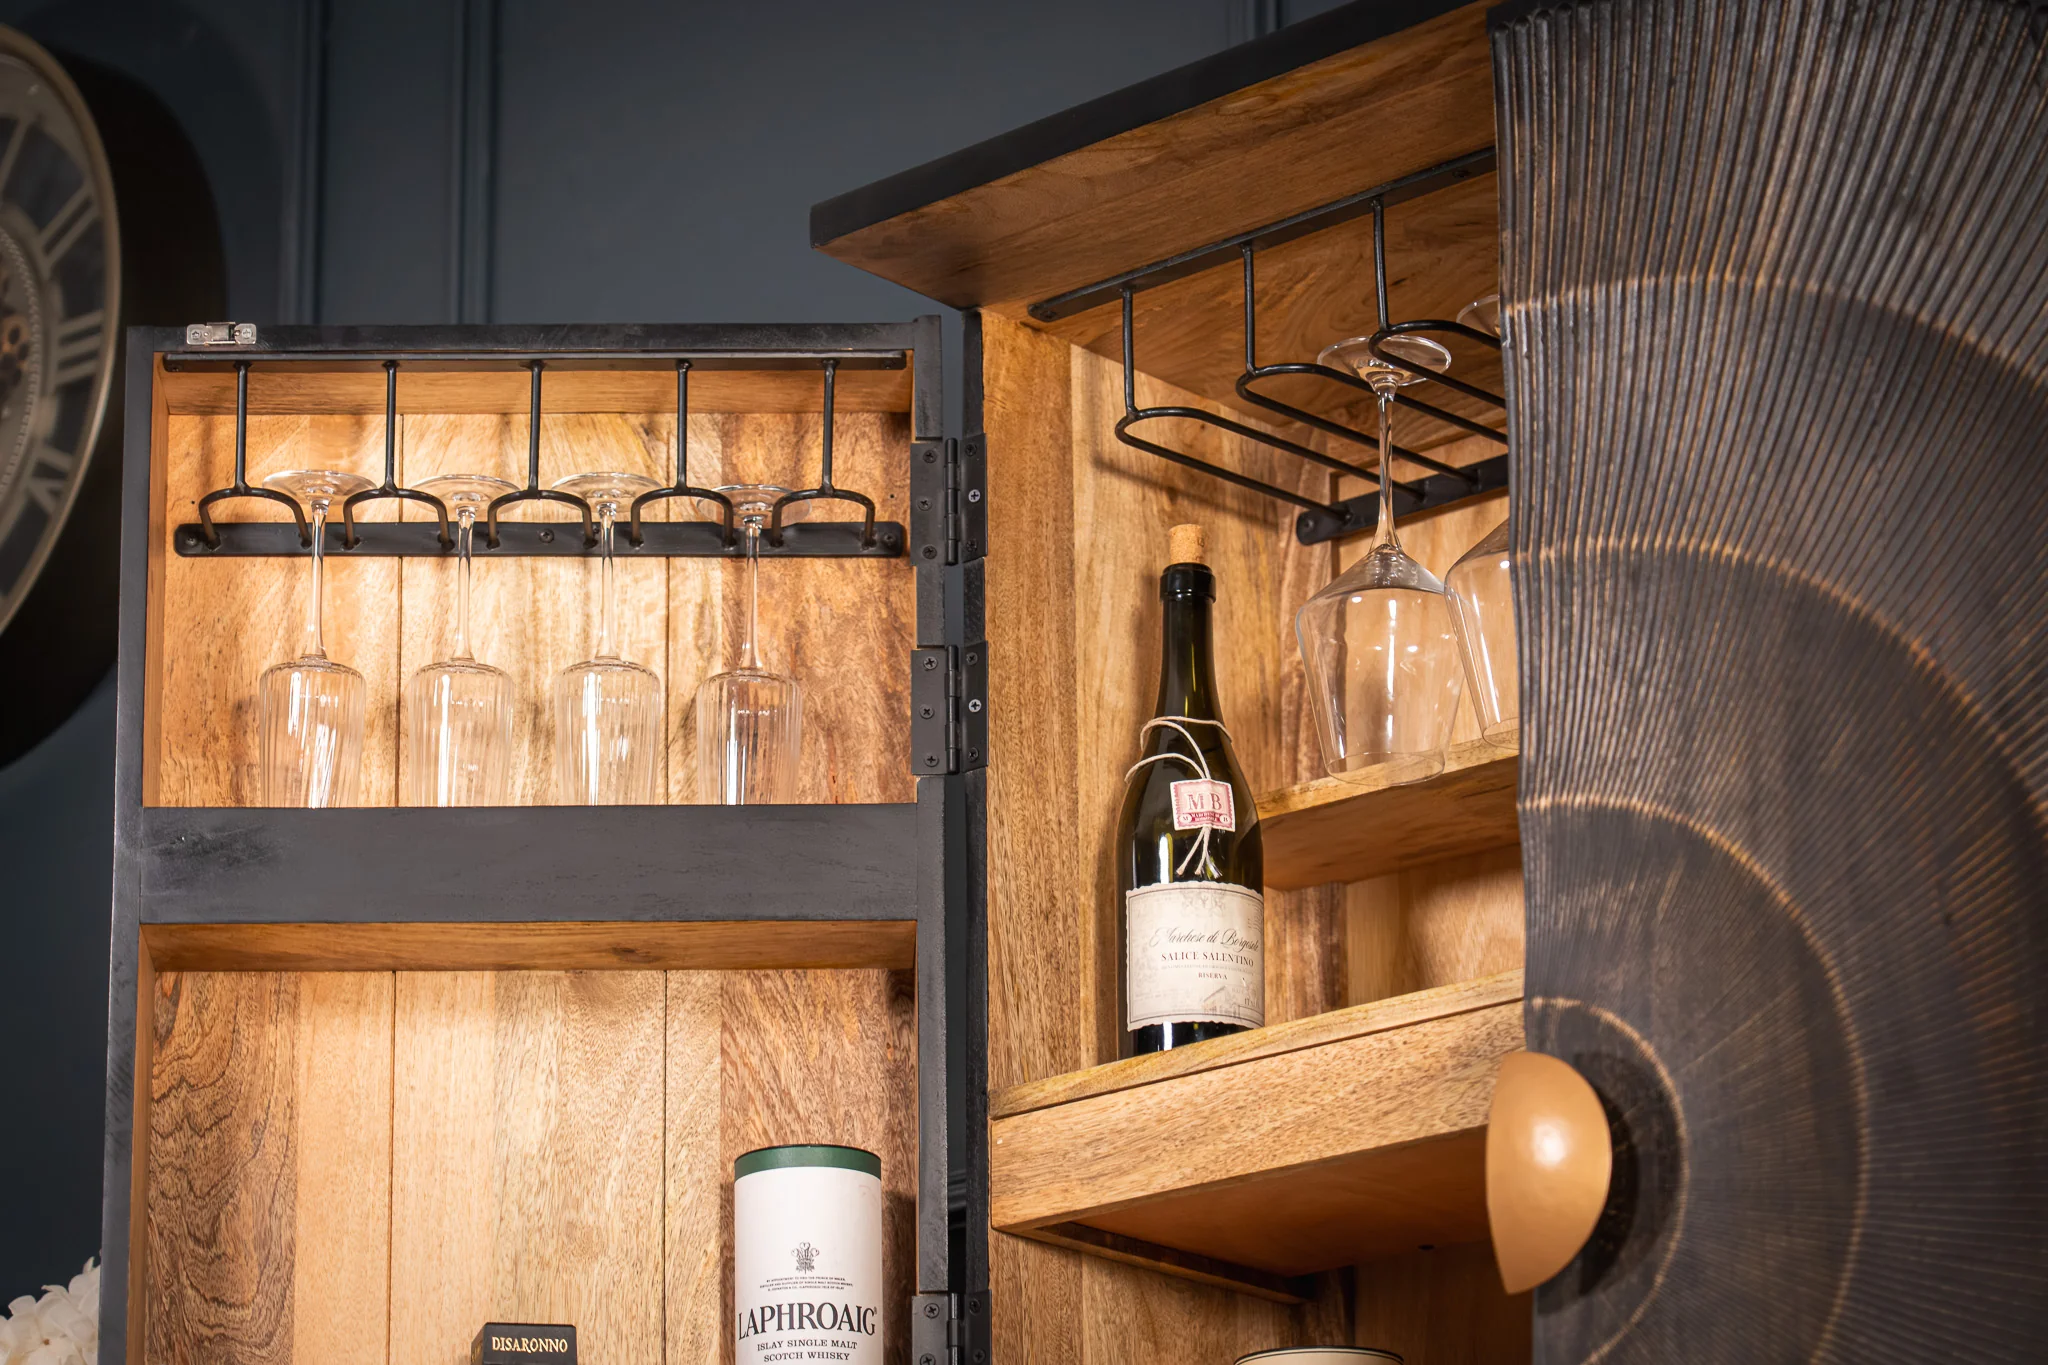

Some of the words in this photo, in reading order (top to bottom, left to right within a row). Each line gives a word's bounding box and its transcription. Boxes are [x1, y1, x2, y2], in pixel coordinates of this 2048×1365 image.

[1188, 794, 1205, 810] M
[1210, 793, 1222, 810] B
[1206, 930, 1219, 943] di
[1161, 951, 1200, 962] SALICE
[1202, 952, 1254, 967] SALENTINO
[1197, 972, 1229, 981] RISERVA
[491, 1336, 568, 1354] DISARONNO
[757, 1341, 783, 1352] ISLAY
[787, 1339, 828, 1348] SINGLE
[831, 1340, 858, 1350] MALT
[763, 1351, 804, 1362] SCOTCH
[807, 1351, 850, 1361] WHISKY
